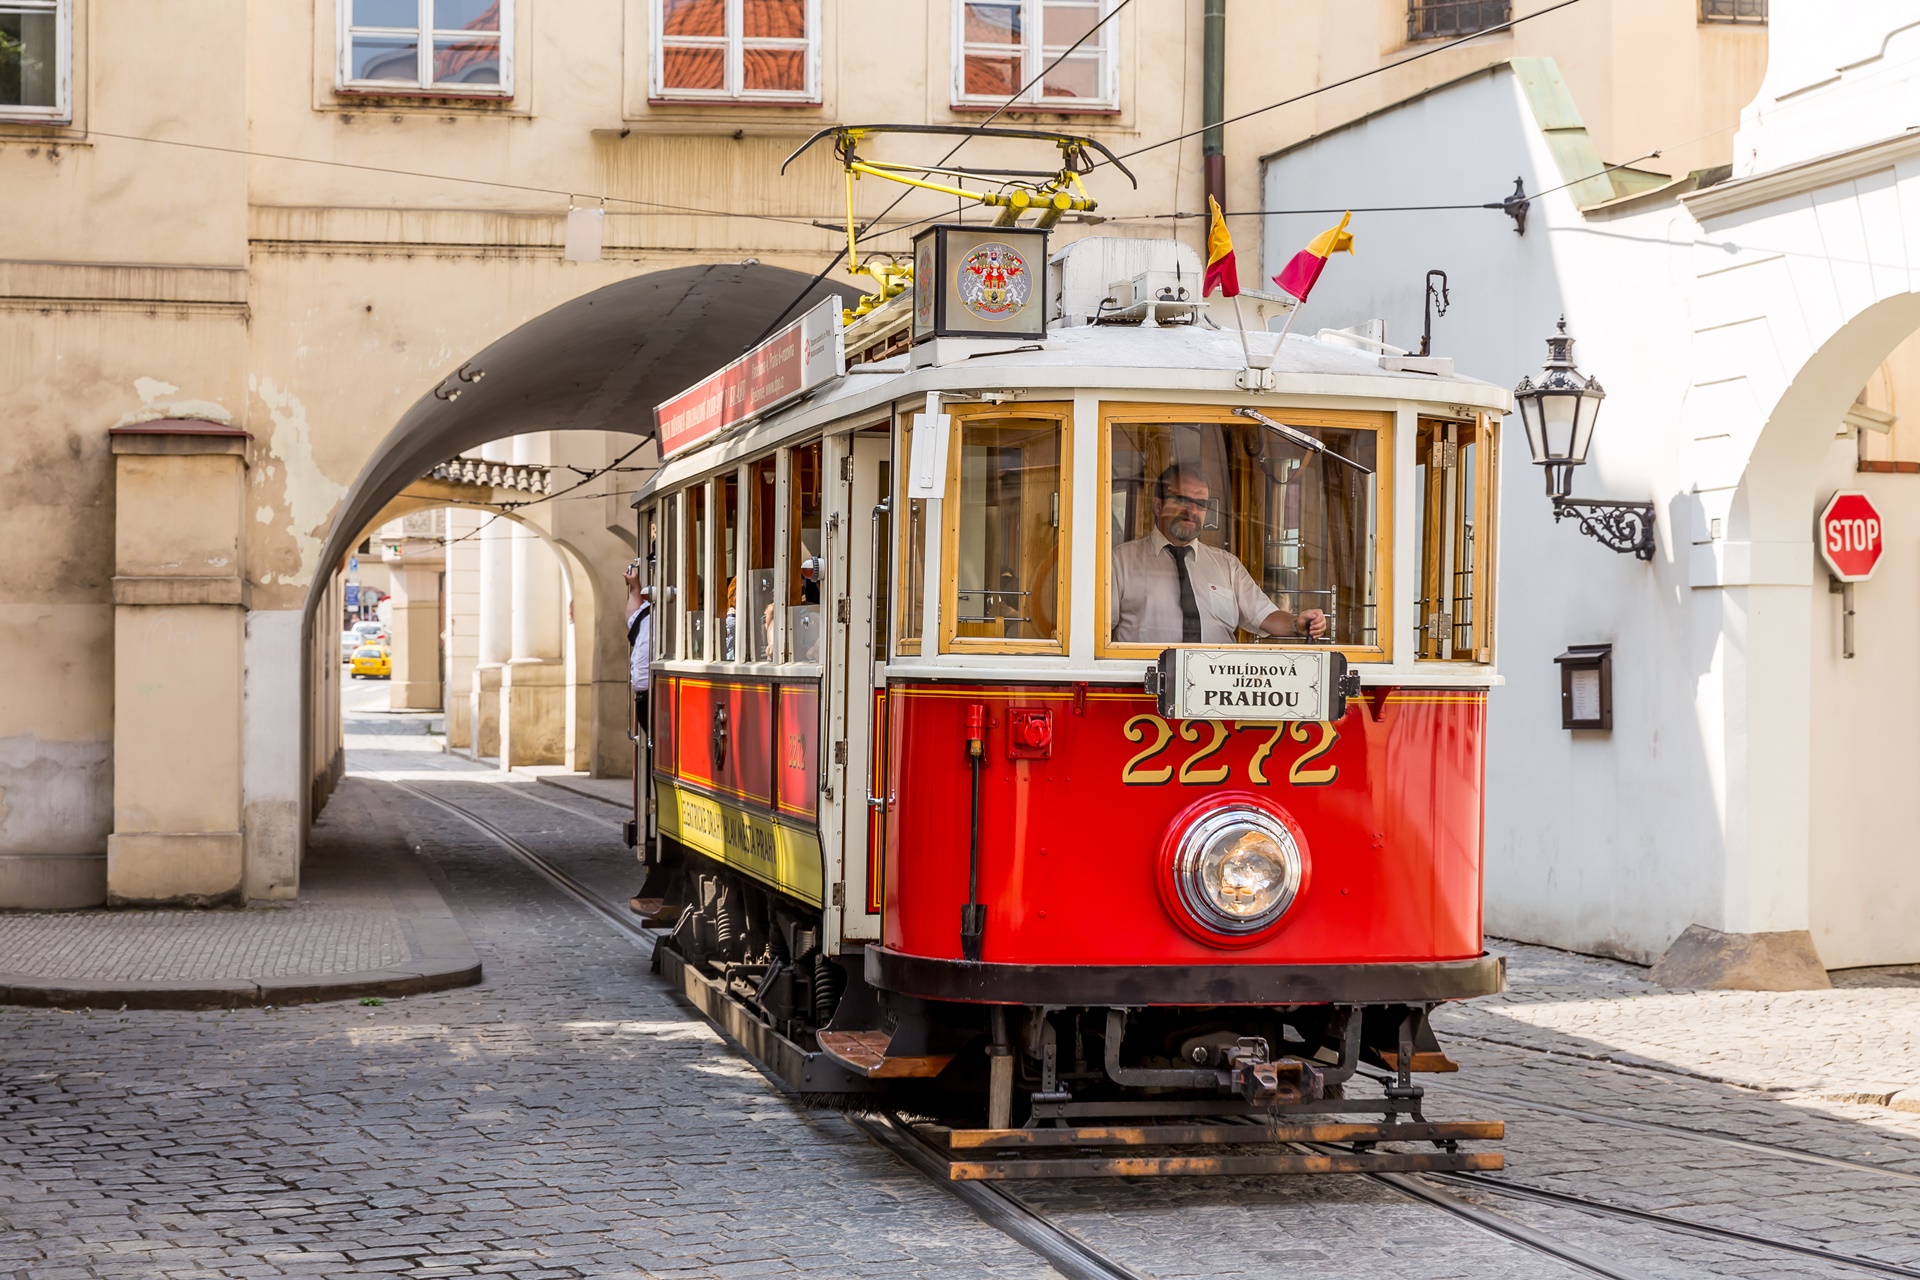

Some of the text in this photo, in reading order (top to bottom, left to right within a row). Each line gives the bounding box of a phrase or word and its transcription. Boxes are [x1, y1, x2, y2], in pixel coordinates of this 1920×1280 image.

[1828, 518, 1879, 553] STOP
[1208, 661, 1298, 677] VYHLÍDKOVÁ
[1232, 675, 1273, 689] JÍZDA
[1203, 690, 1300, 708] PRAHOU
[788, 732, 807, 771] 2272
[1122, 713, 1341, 786] 2272
